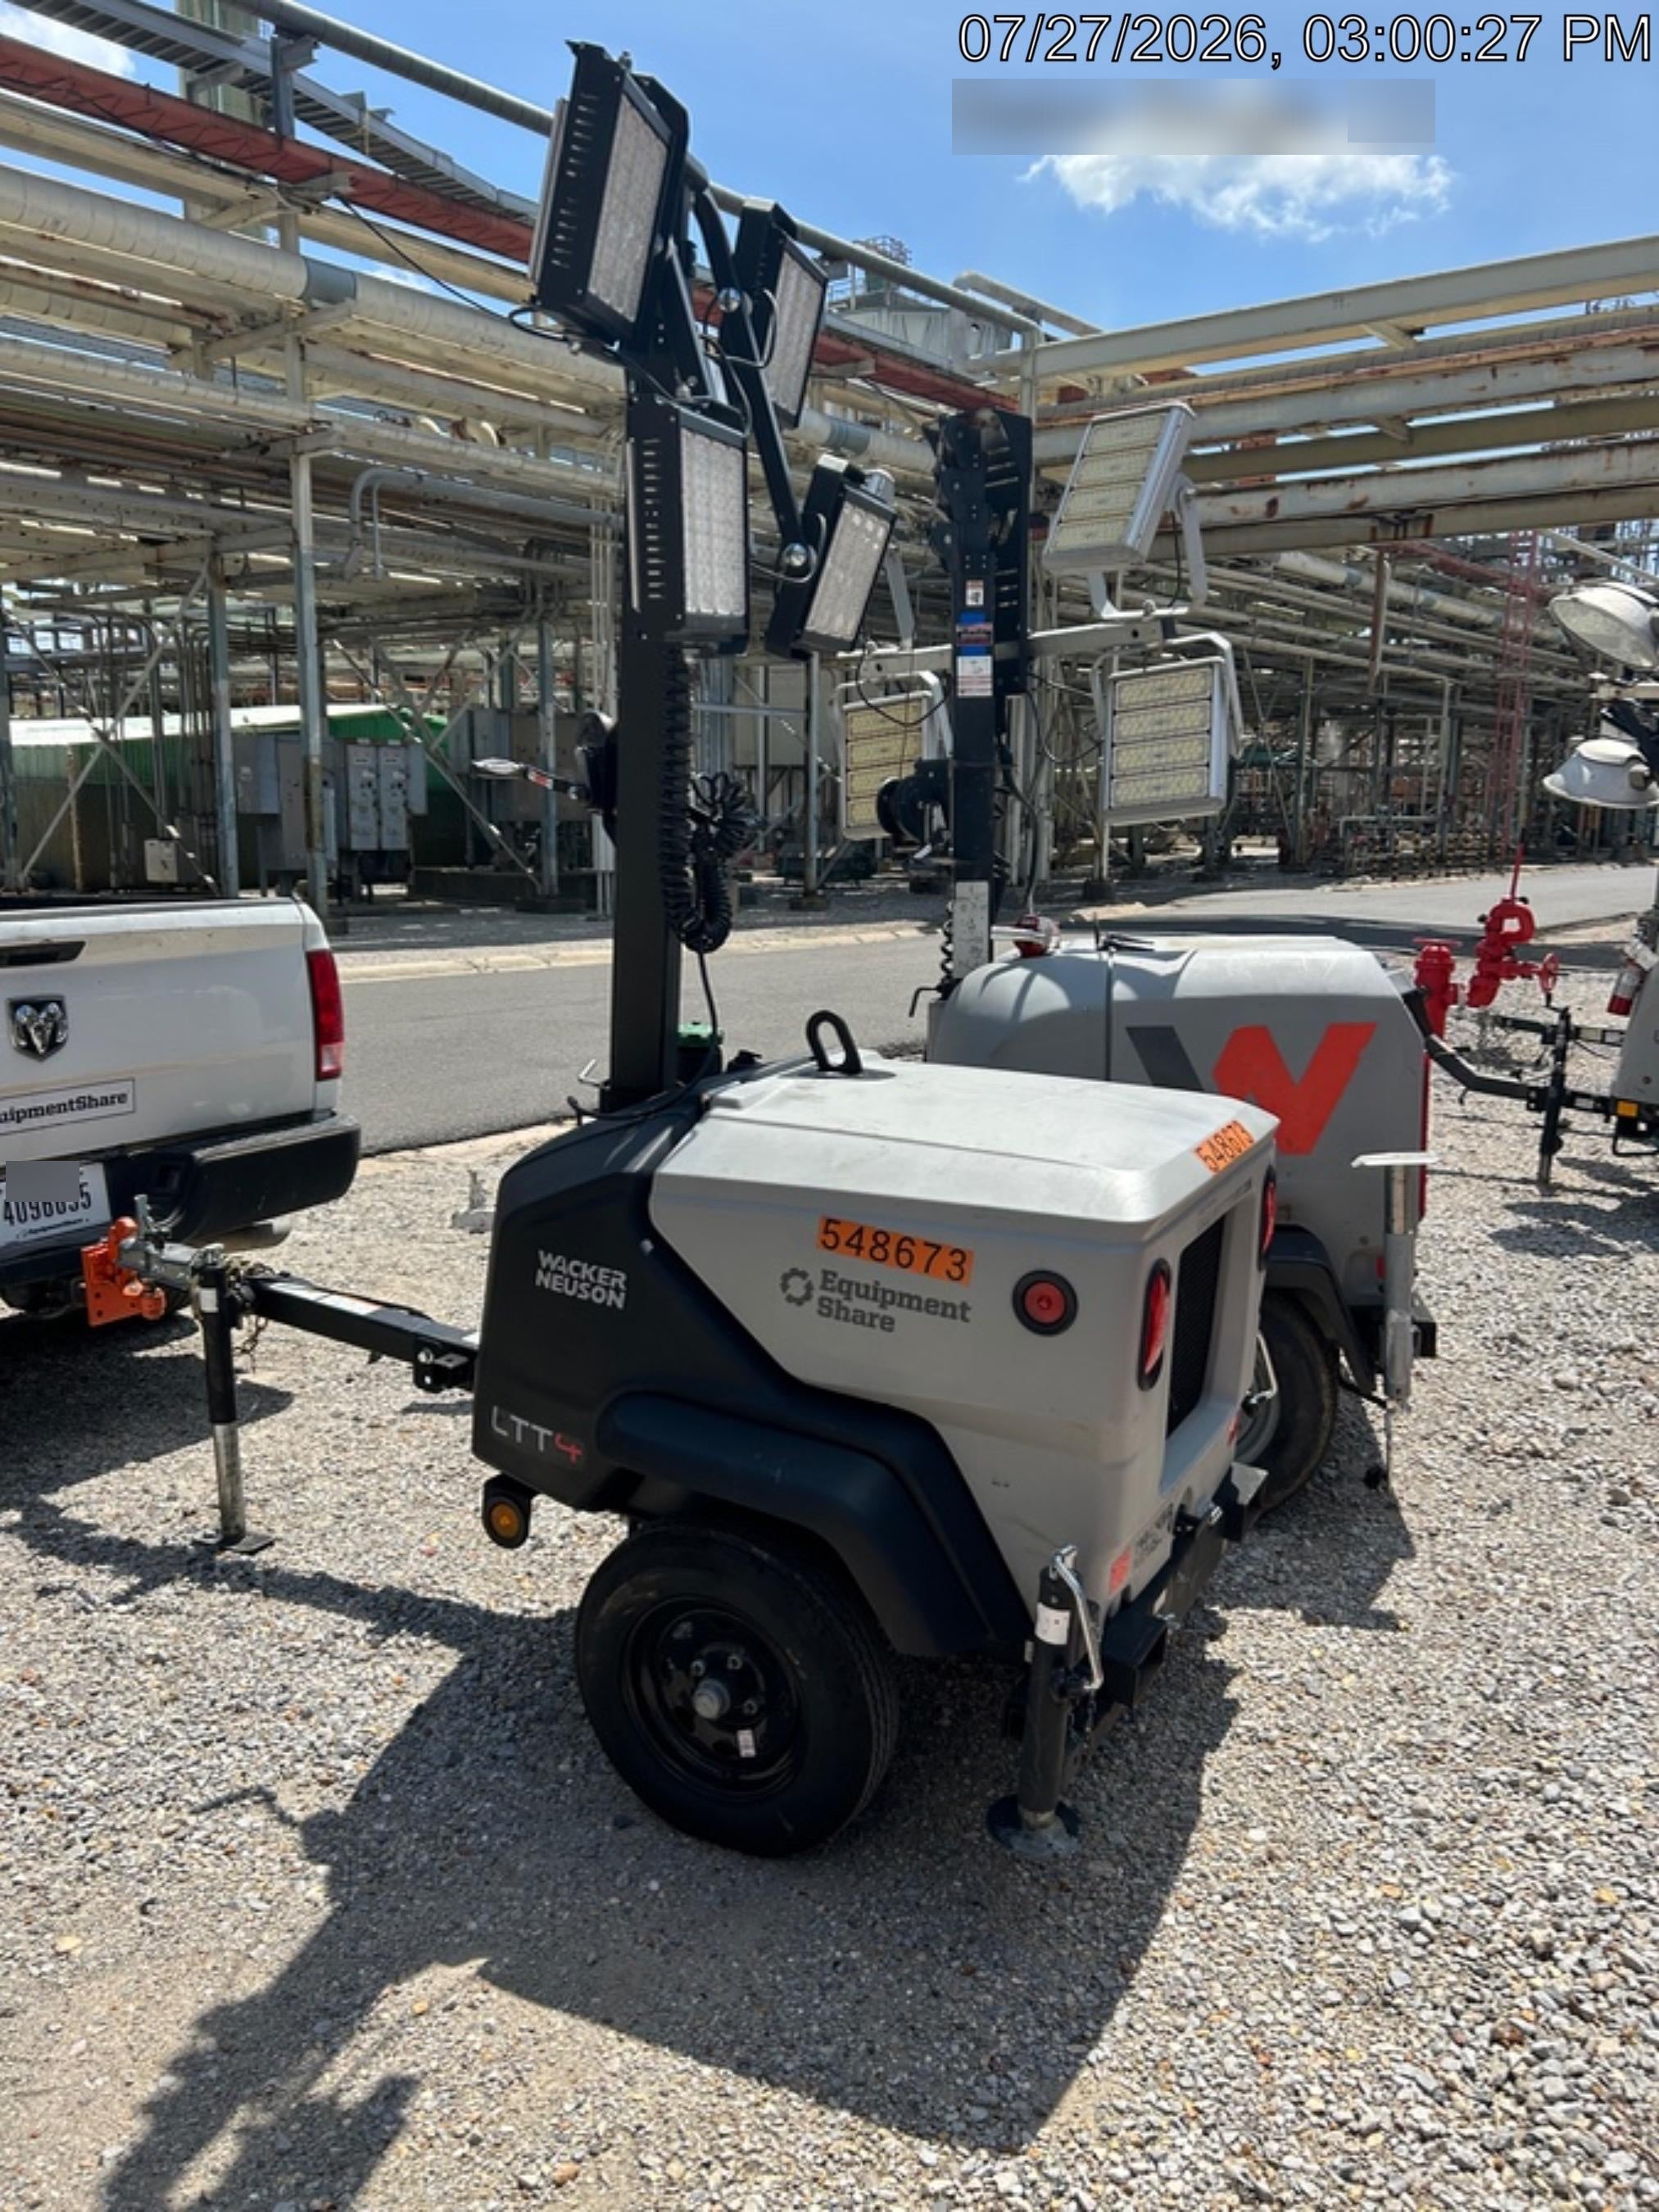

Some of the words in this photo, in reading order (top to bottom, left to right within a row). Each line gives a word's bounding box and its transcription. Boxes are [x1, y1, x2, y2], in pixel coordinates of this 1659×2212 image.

[537, 1249, 628, 1291] WACKER
[820, 1218, 968, 1282] 548673
[535, 1268, 627, 1309] NEUSON
[820, 1269, 972, 1323] Equipment
[817, 1295, 895, 1333] Share
[492, 1405, 583, 1464] LTT4
